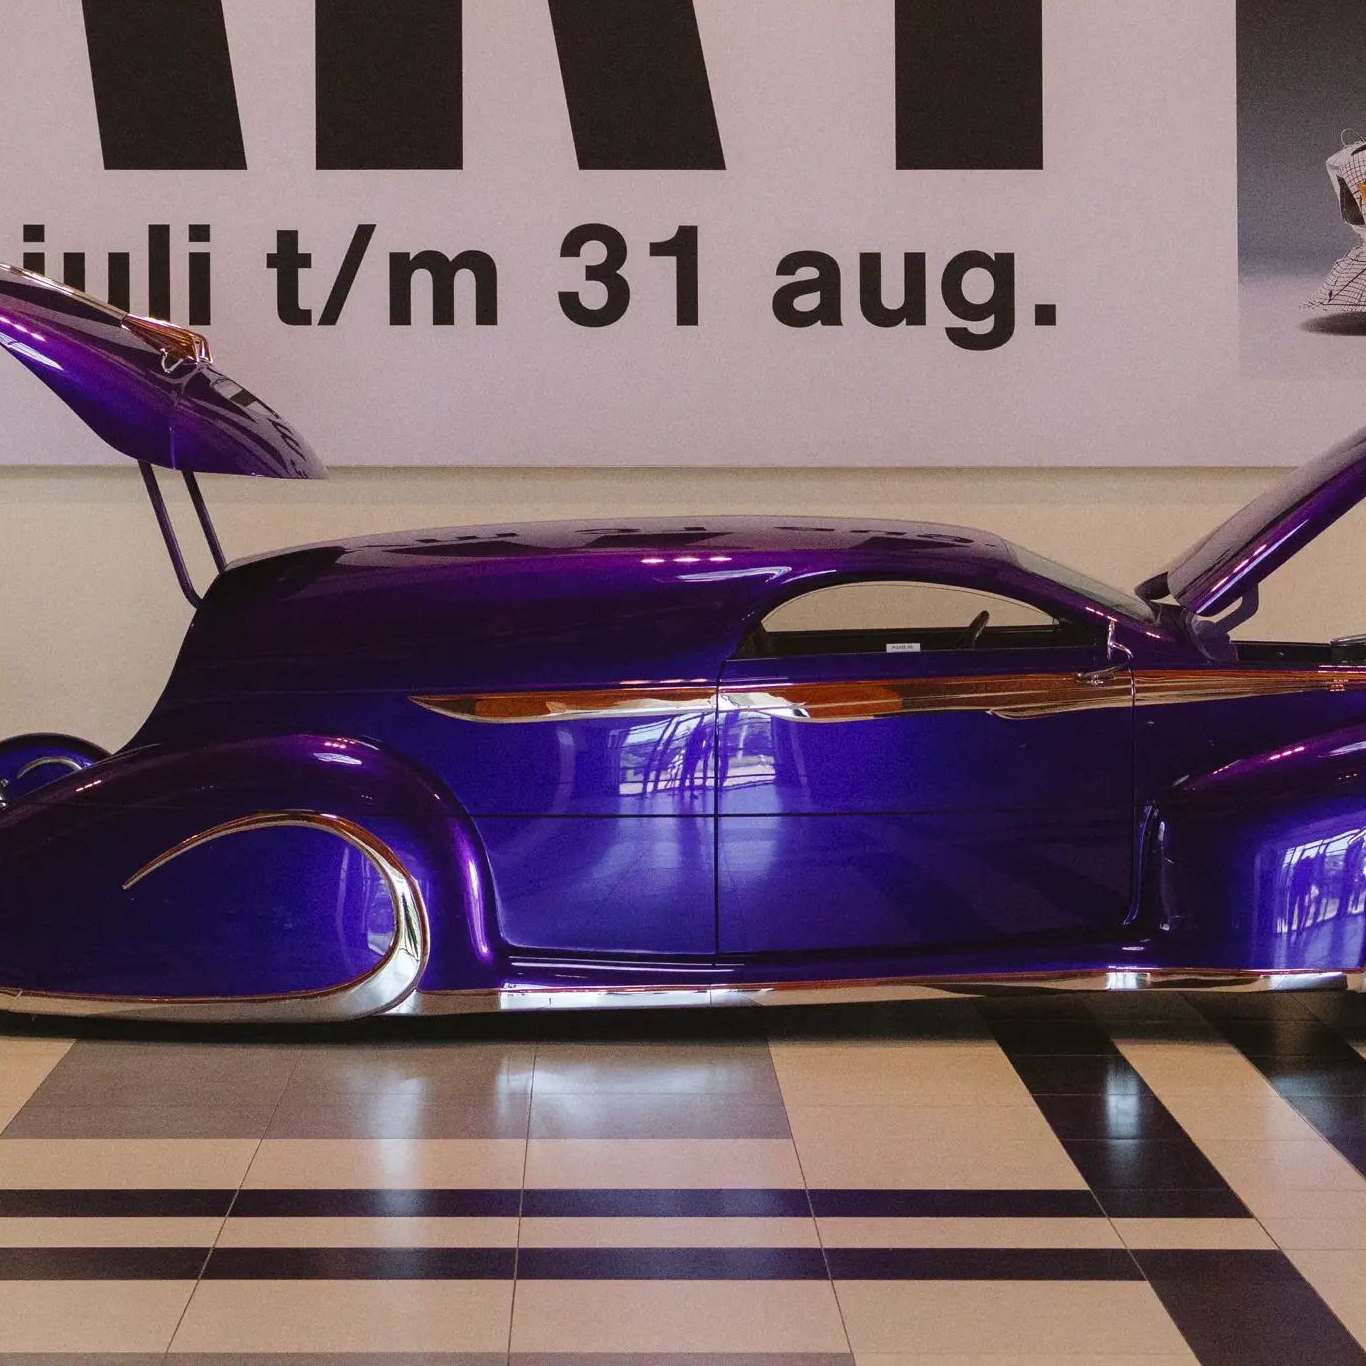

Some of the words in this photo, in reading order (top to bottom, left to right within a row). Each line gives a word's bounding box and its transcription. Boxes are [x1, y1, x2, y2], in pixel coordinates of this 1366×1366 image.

[266, 224, 498, 326] t/m
[557, 224, 699, 328] 31
[771, 250, 1057, 351] aug.
